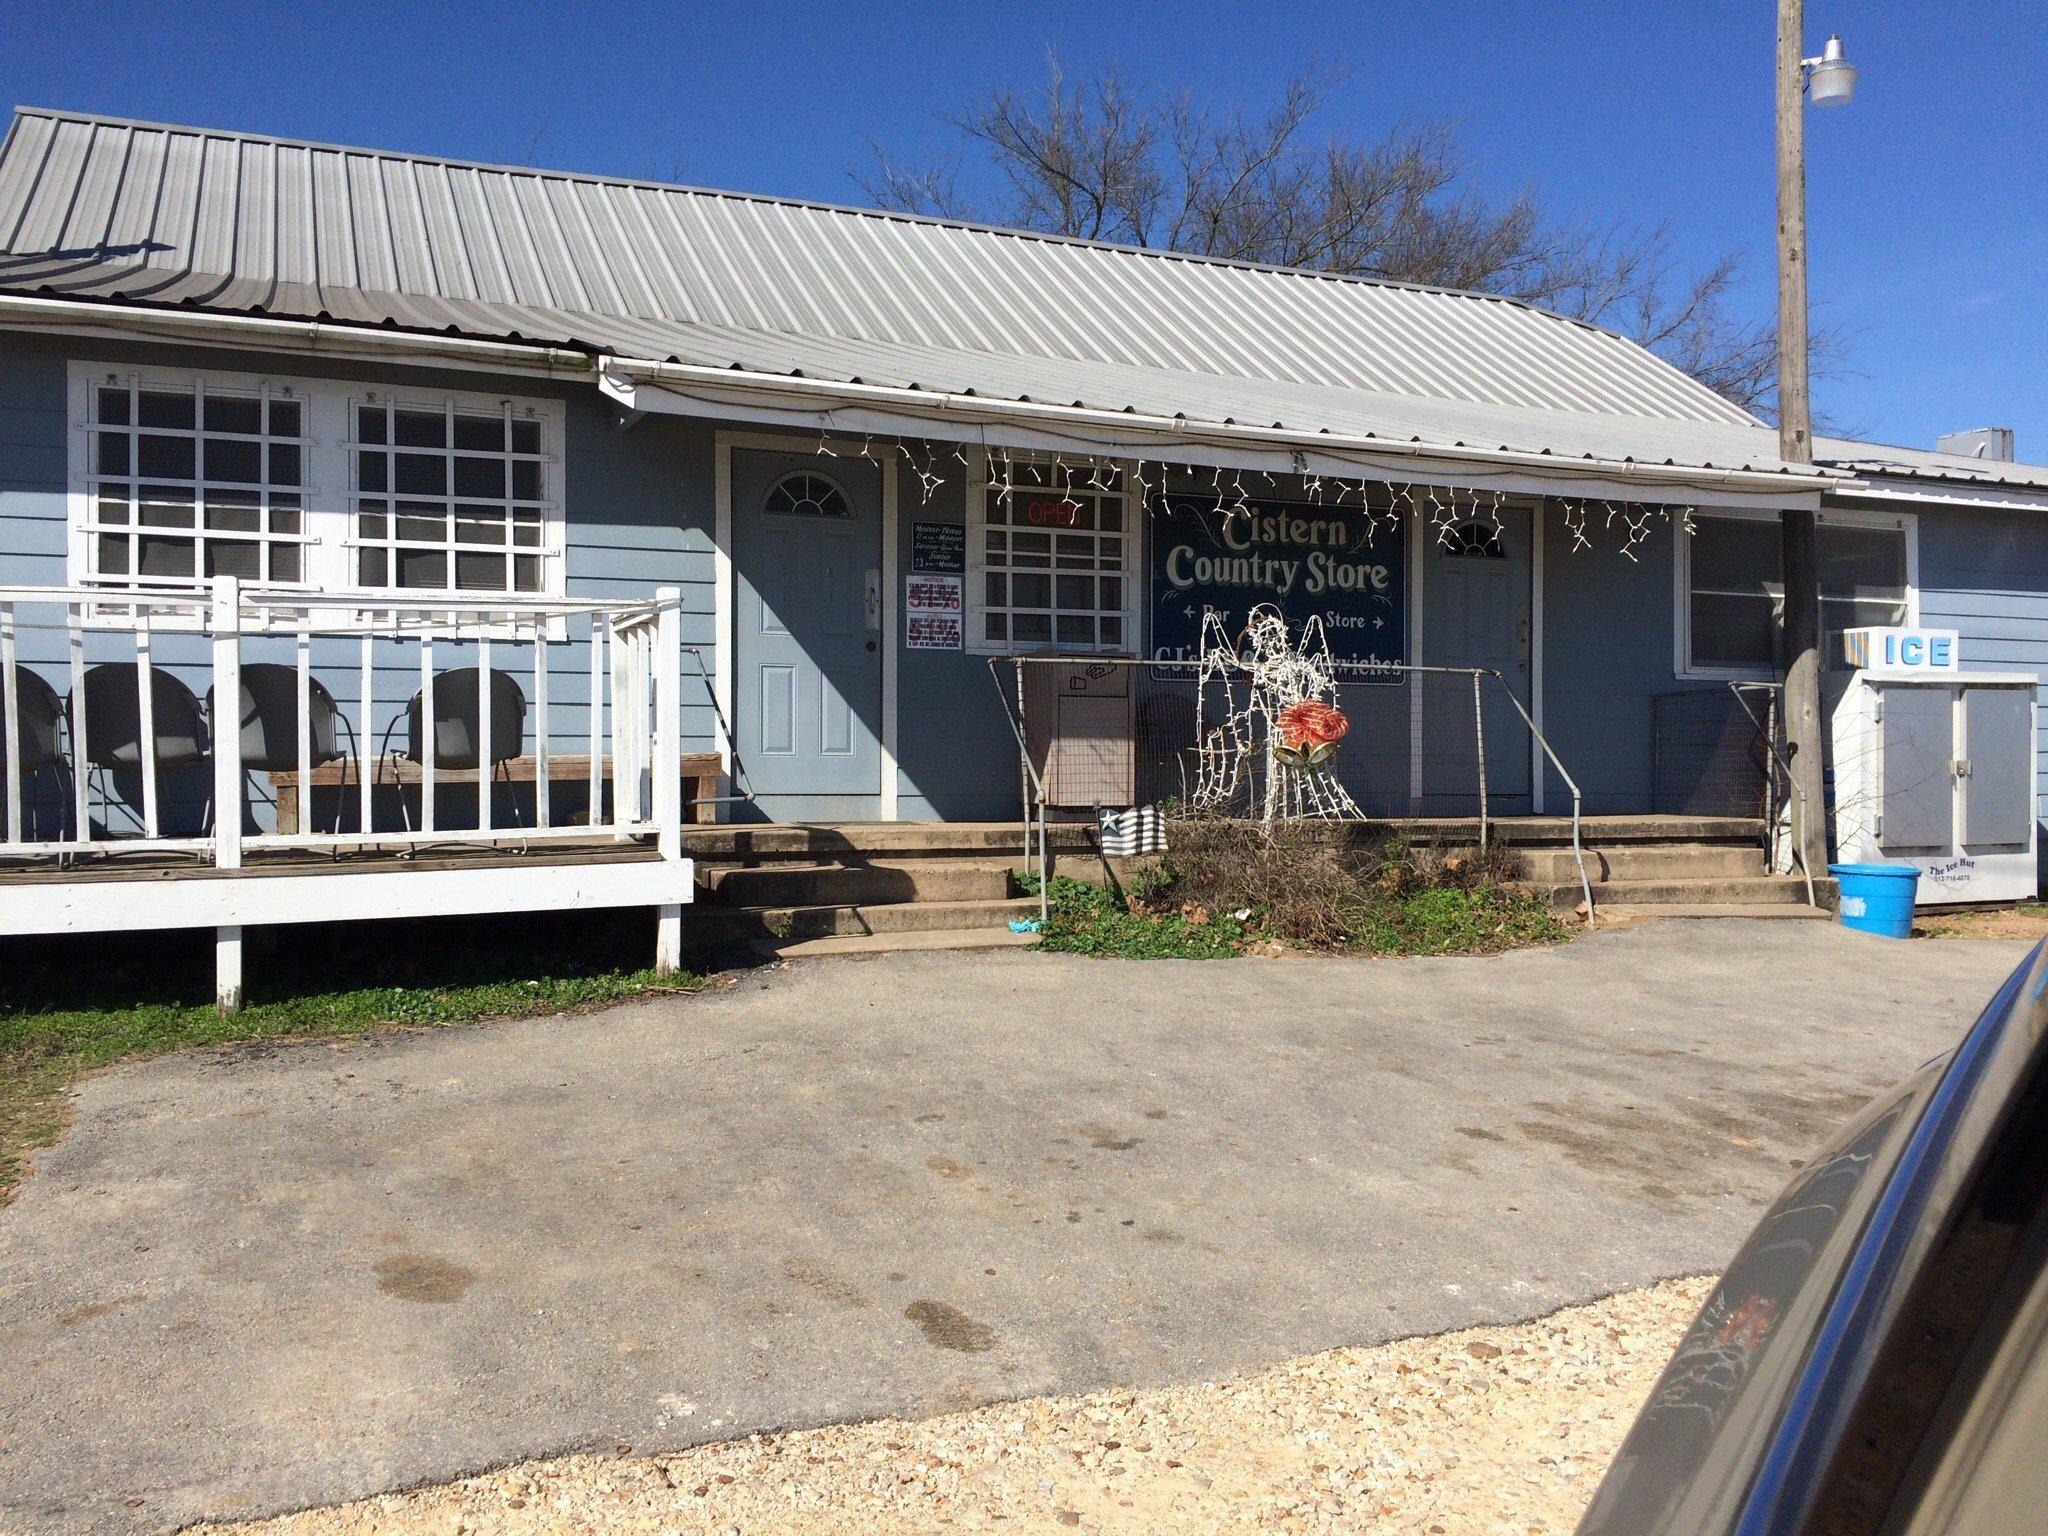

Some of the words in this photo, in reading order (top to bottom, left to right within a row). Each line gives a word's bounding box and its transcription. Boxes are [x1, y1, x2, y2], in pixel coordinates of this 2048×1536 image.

[1027, 501, 1082, 526] OPEN
[1224, 506, 1348, 550] Cistern
[1166, 545, 1300, 594] Country
[1305, 551, 1390, 594] Store
[1203, 604, 1231, 622] Bar
[1326, 610, 1366, 629] Store
[1154, 644, 1198, 672] CJ's
[1885, 634, 1952, 667] ICE
[1929, 866, 1945, 876] The
[1945, 862, 1958, 873] Ice
[1959, 857, 1975, 869] Hut
